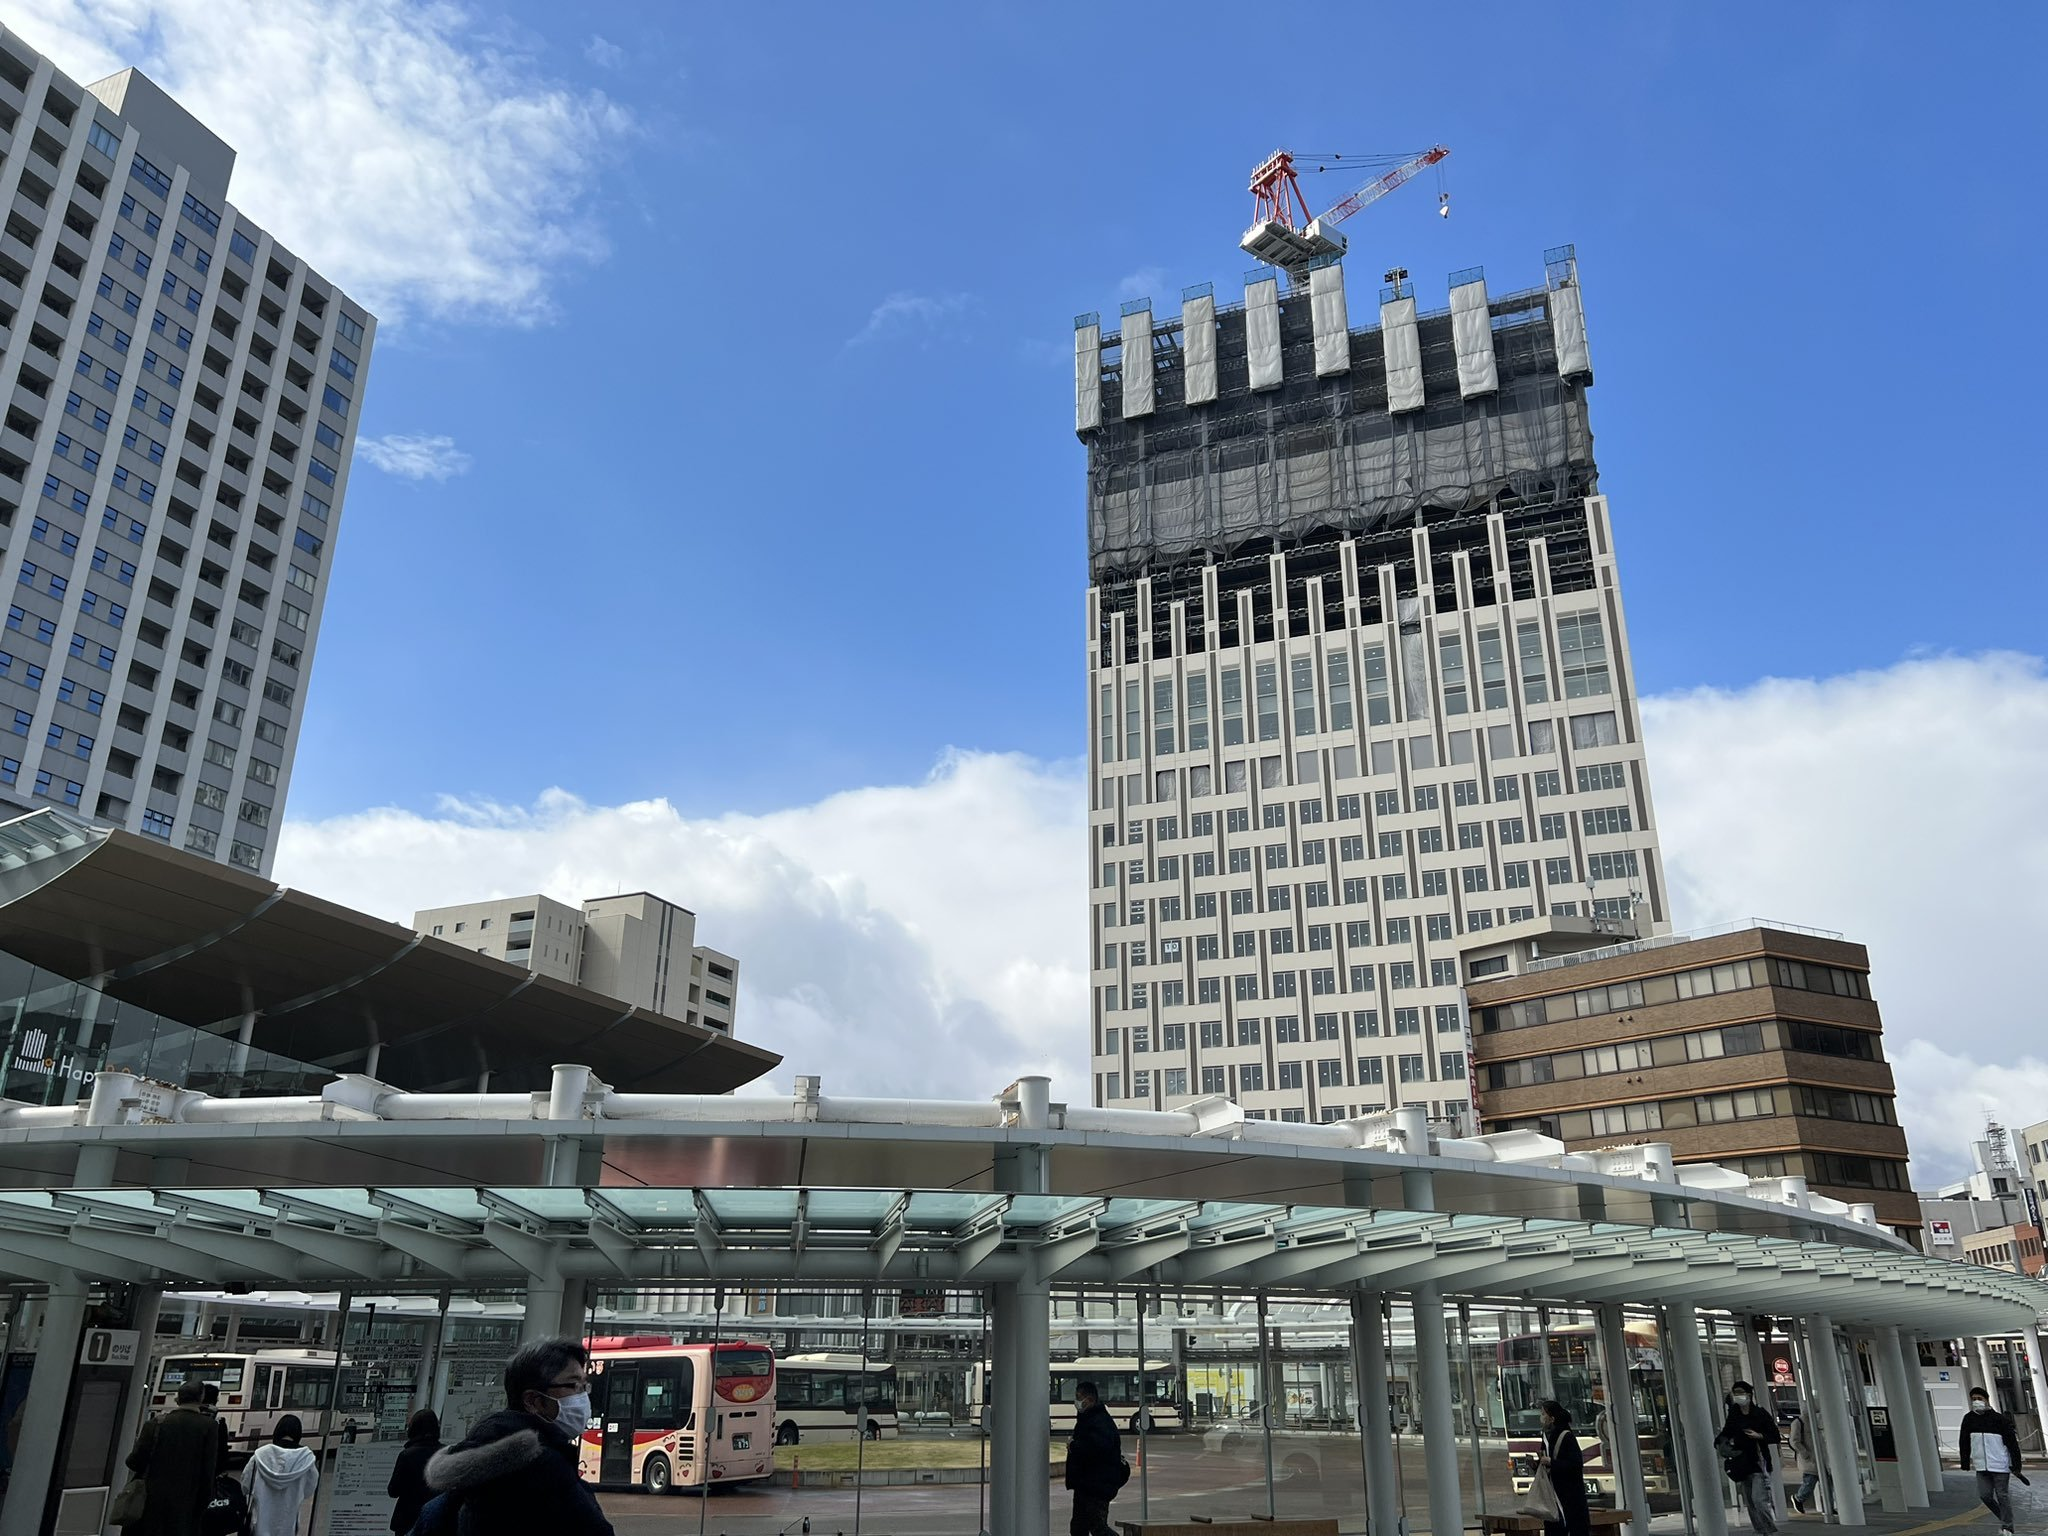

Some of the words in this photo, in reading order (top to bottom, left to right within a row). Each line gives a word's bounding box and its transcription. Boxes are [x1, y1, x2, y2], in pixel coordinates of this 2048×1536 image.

[97, 1335, 105, 1358] 1
[112, 1344, 131, 1354] のりば
